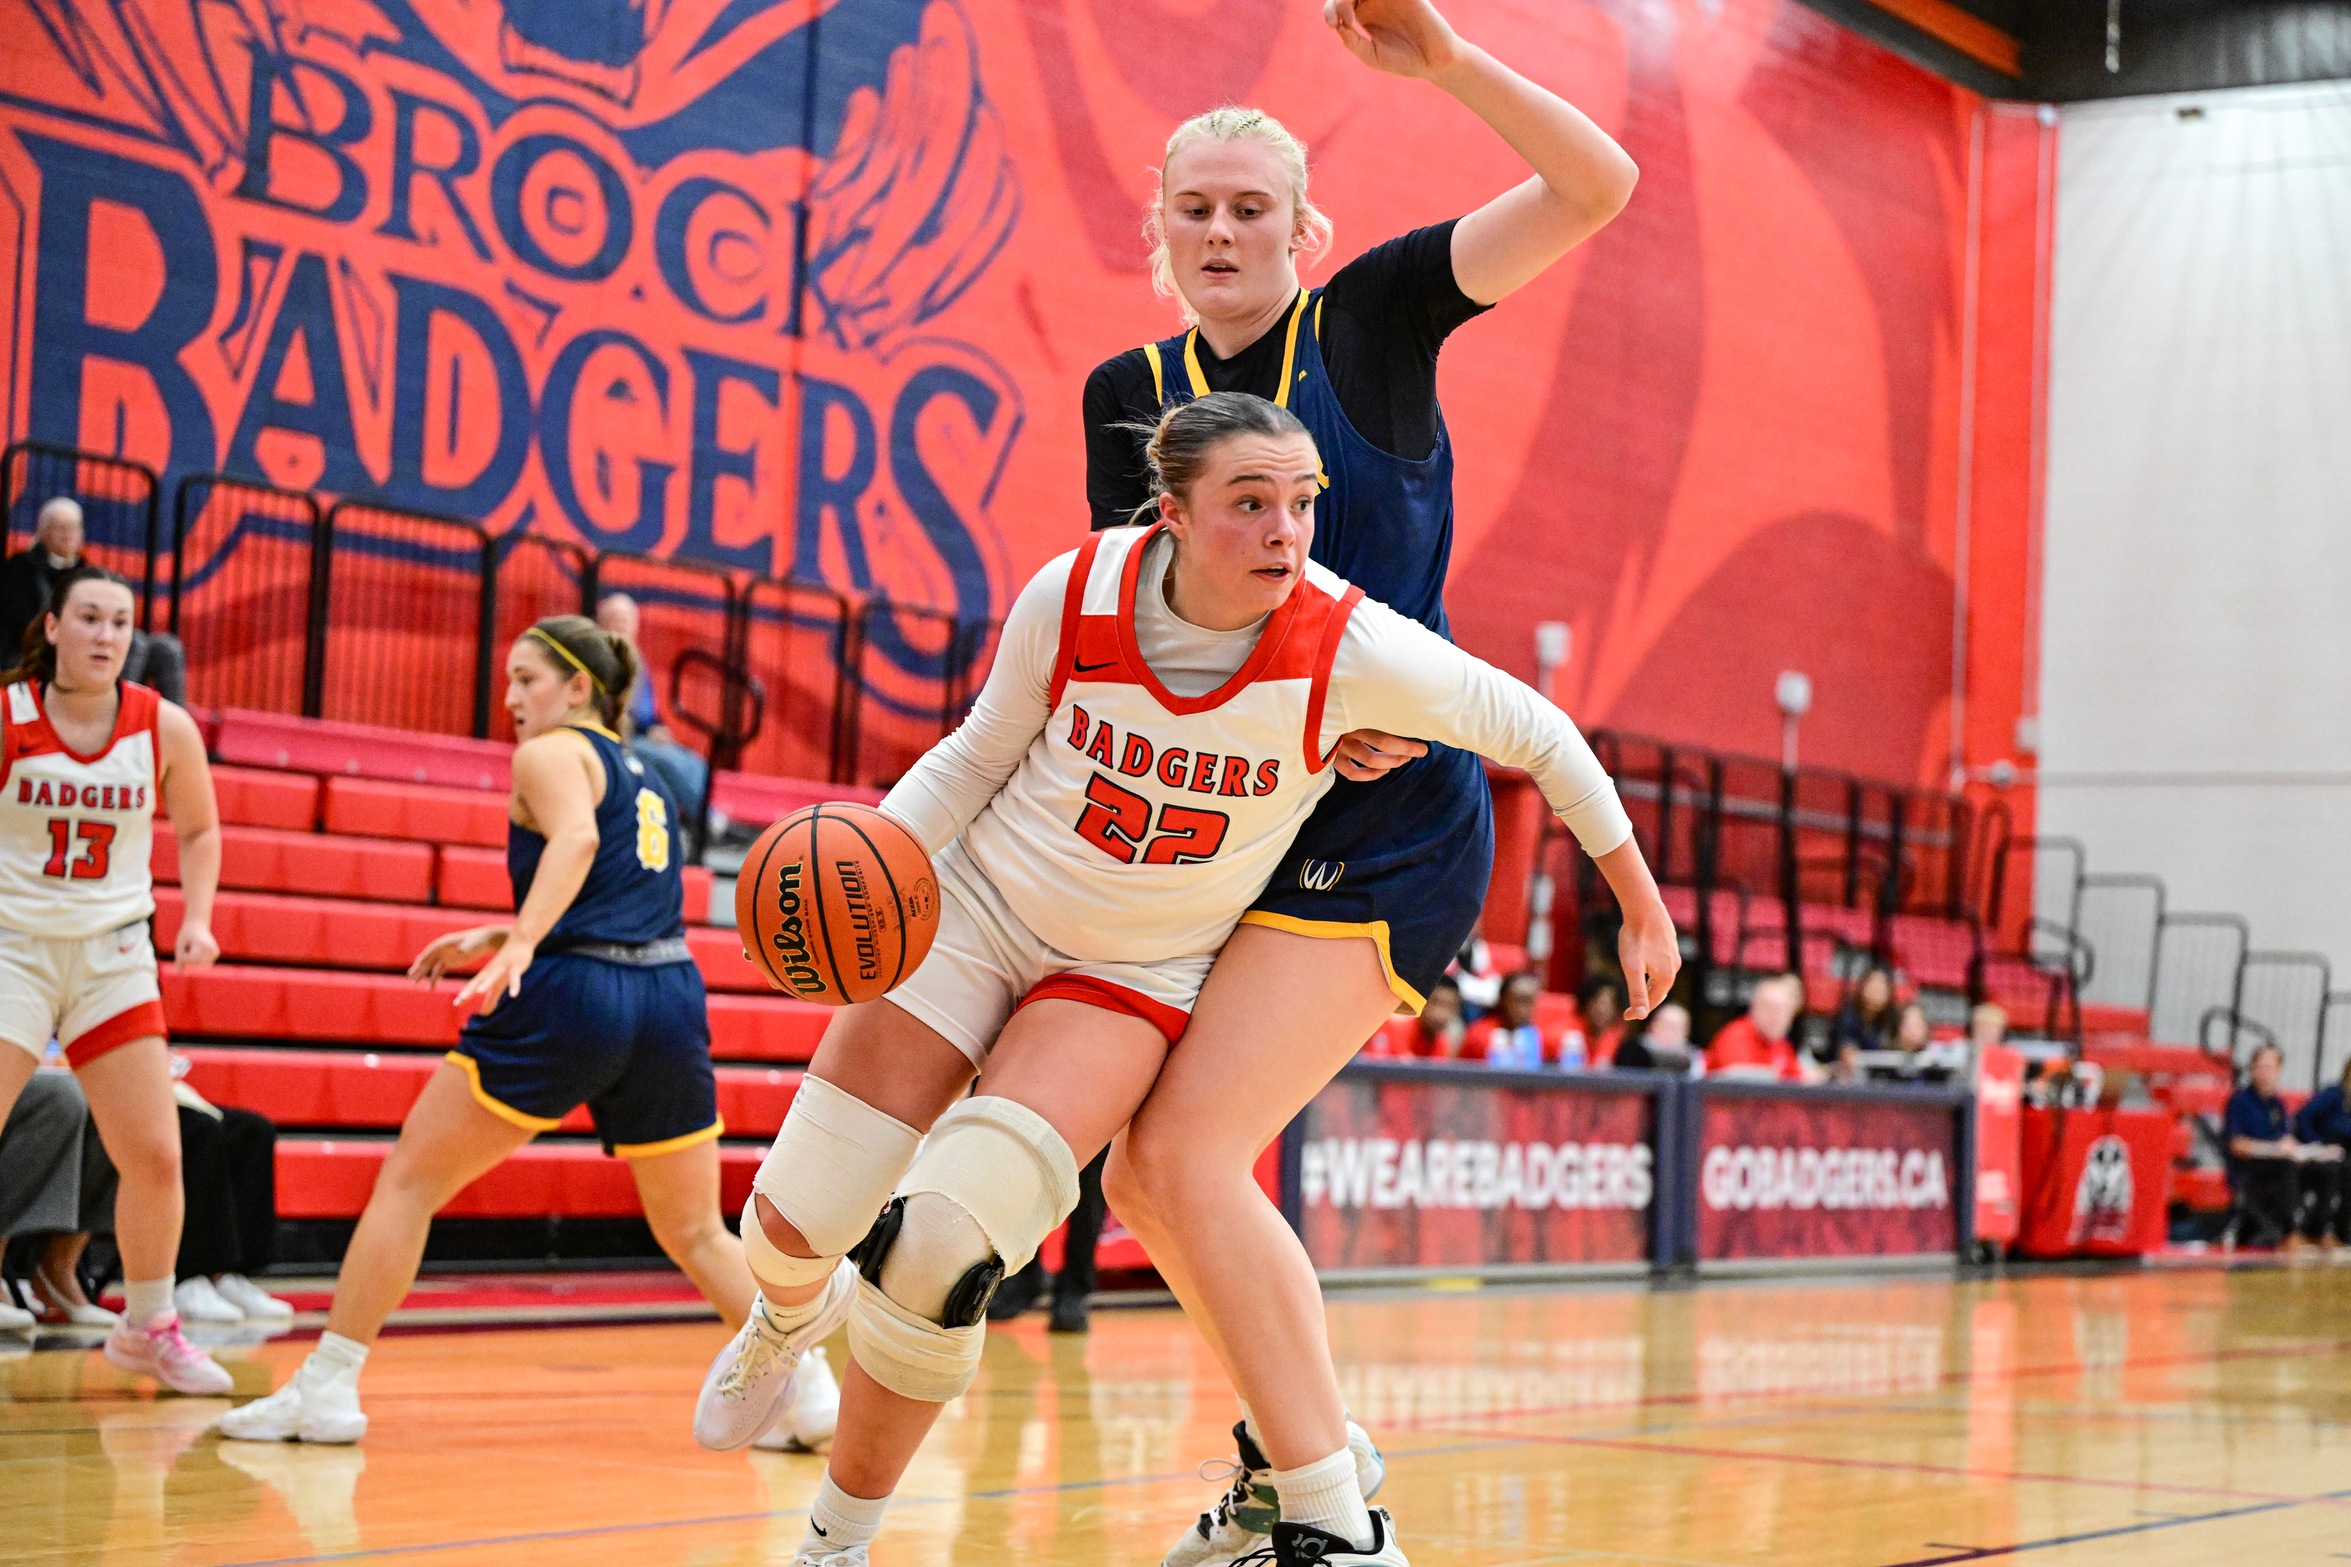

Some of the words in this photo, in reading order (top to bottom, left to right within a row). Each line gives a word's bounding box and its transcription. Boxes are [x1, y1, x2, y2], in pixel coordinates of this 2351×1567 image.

[232, 44, 872, 349] BROCK
[12, 127, 1000, 680] BADGERS
[18, 777, 146, 809] BADGERS
[1067, 703, 1280, 797] BADGERS
[43, 818, 117, 880] 13
[635, 786, 670, 874] 6
[1073, 770, 1230, 865] 22
[773, 861, 827, 995] Wilson
[836, 861, 877, 981] EVOLUTION
[1300, 1137, 1652, 1209] #WEAREBADGERS
[1702, 1145, 1945, 1211] GOBADGERS.CA
